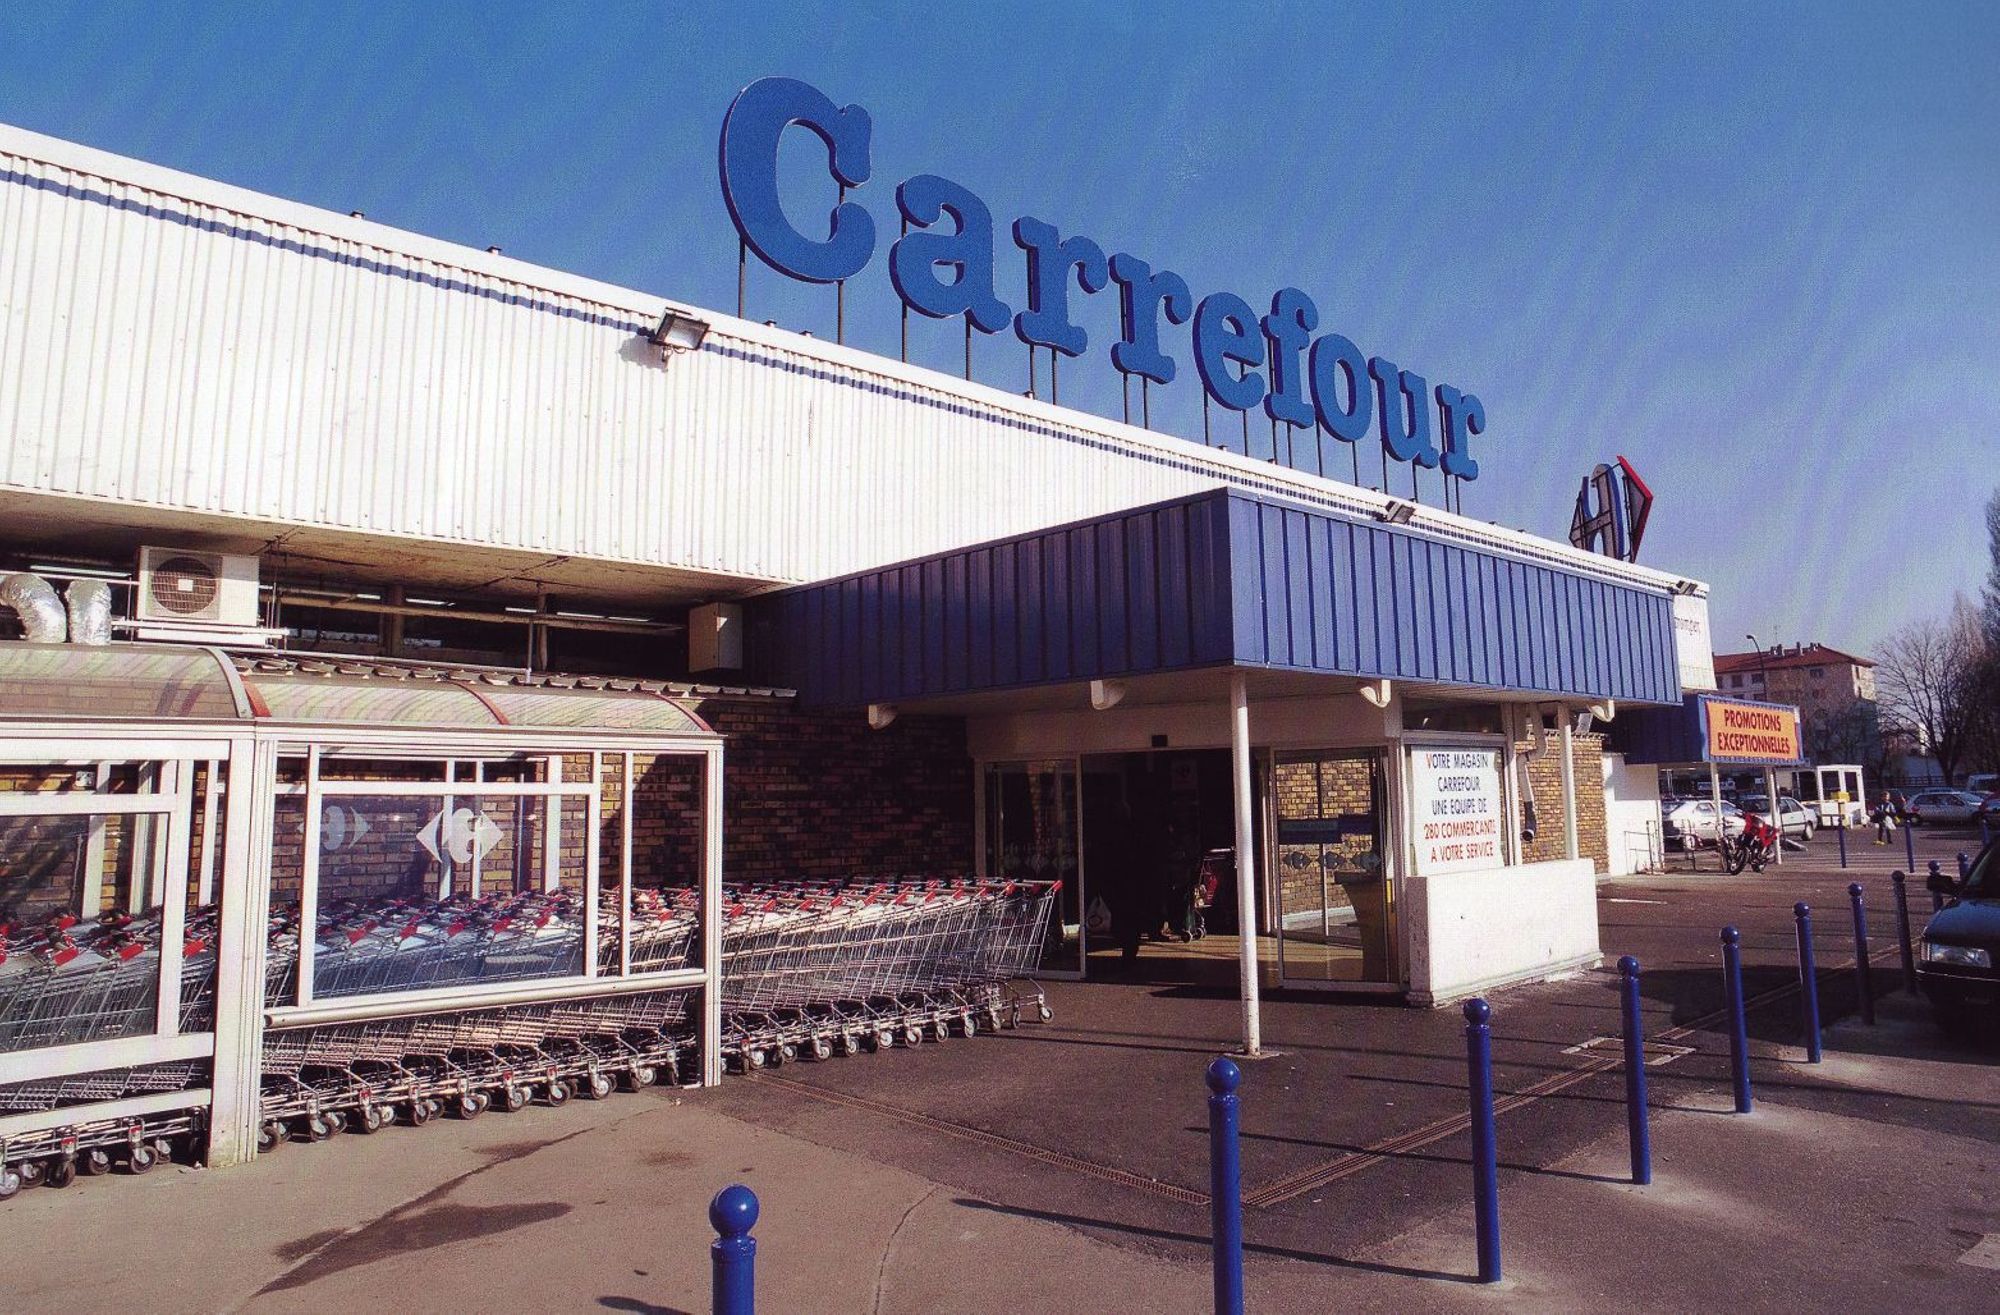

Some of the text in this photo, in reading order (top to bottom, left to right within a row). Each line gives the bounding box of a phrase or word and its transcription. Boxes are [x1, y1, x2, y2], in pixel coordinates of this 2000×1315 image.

[718, 76, 1486, 481] Carrefour
[1724, 709, 1782, 732] PROMOTIONS
[1717, 732, 1791, 754] EXCEPTIONNELLES
[1425, 753, 1489, 769] VOTRE MAGASIN
[1438, 776, 1481, 792] CARREFOUR
[1432, 798, 1488, 815] UNE EQUIPE DE
[1424, 823, 1440, 839] 280
[1431, 841, 1494, 863] A VOTRE SERVICE
